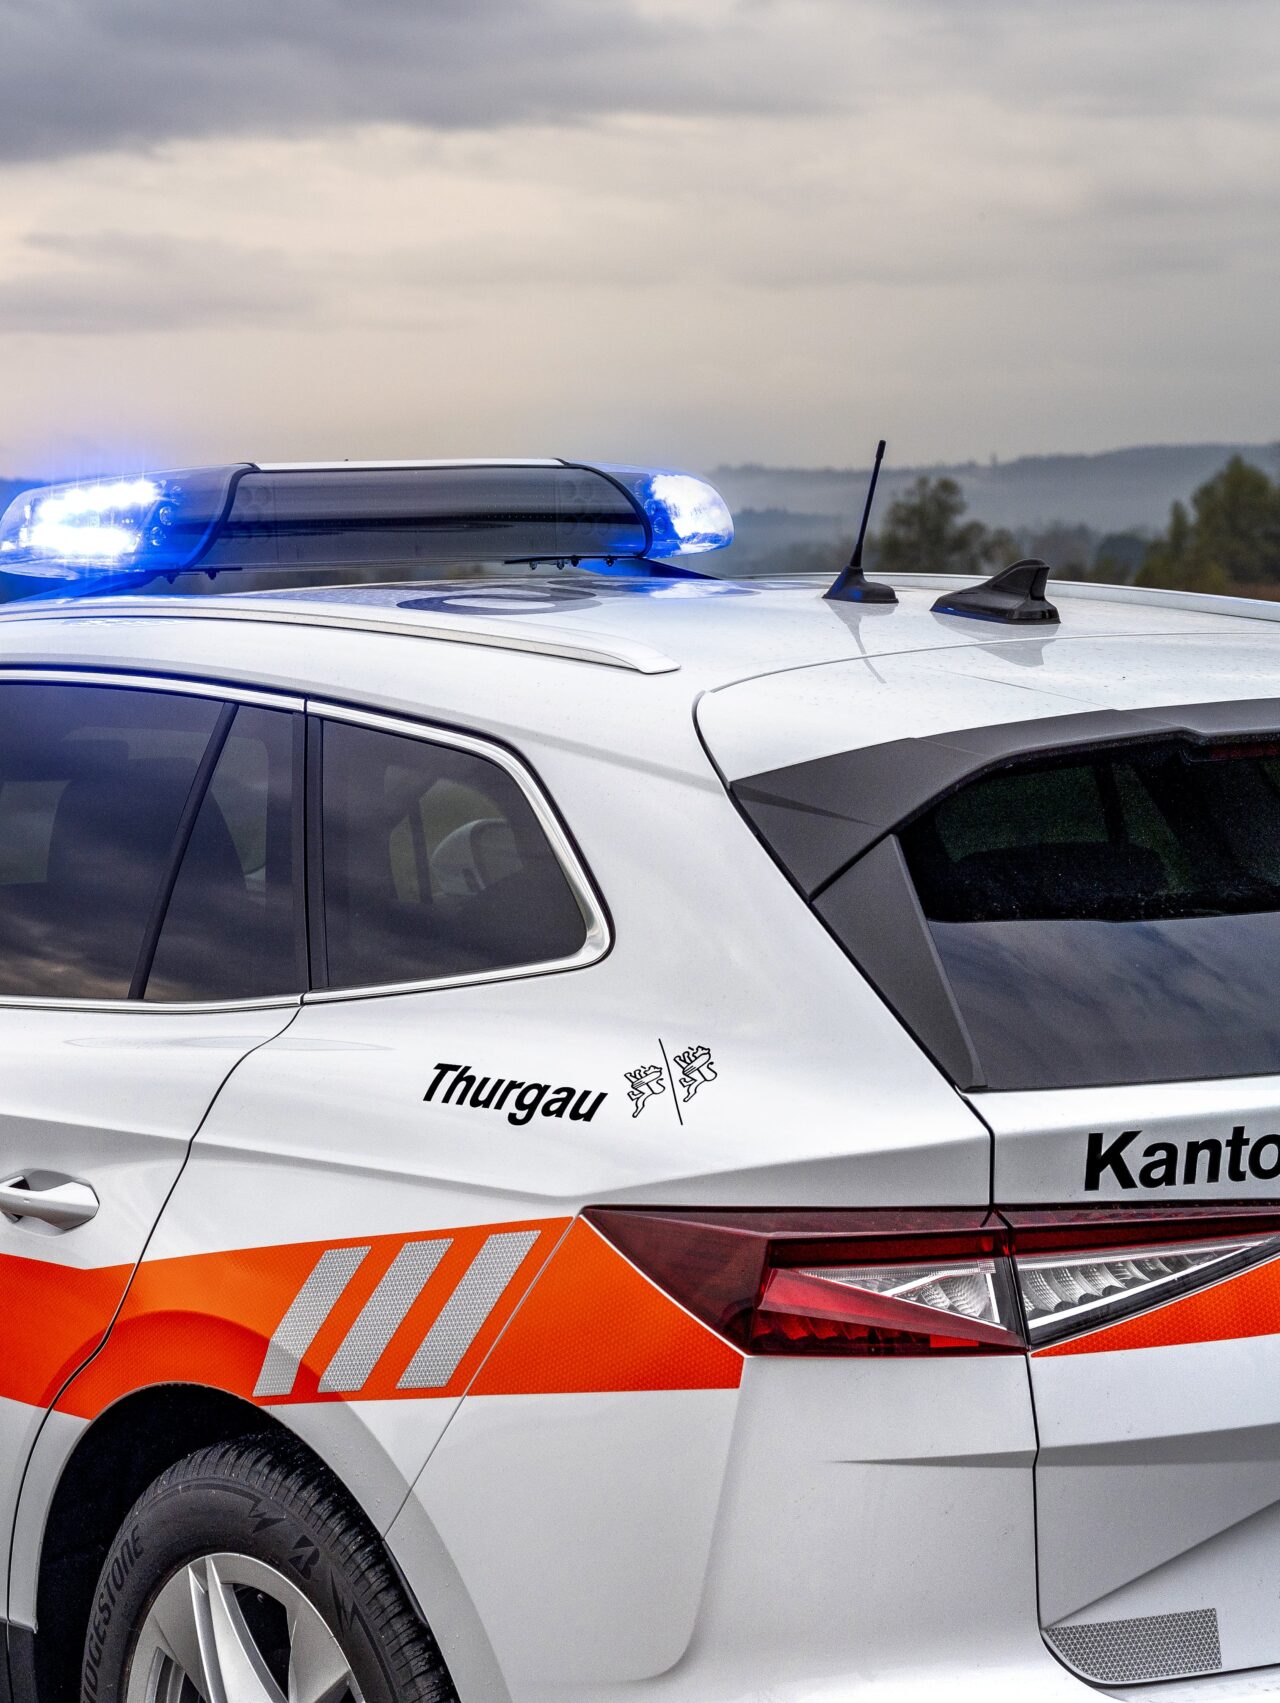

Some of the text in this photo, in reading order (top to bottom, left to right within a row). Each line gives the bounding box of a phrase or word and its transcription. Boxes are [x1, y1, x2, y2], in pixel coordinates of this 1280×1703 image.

[422, 1062, 608, 1126] Thurgau
[1083, 1125, 1280, 1192] Kanto
[82, 1524, 145, 1703] IDGESTONE
